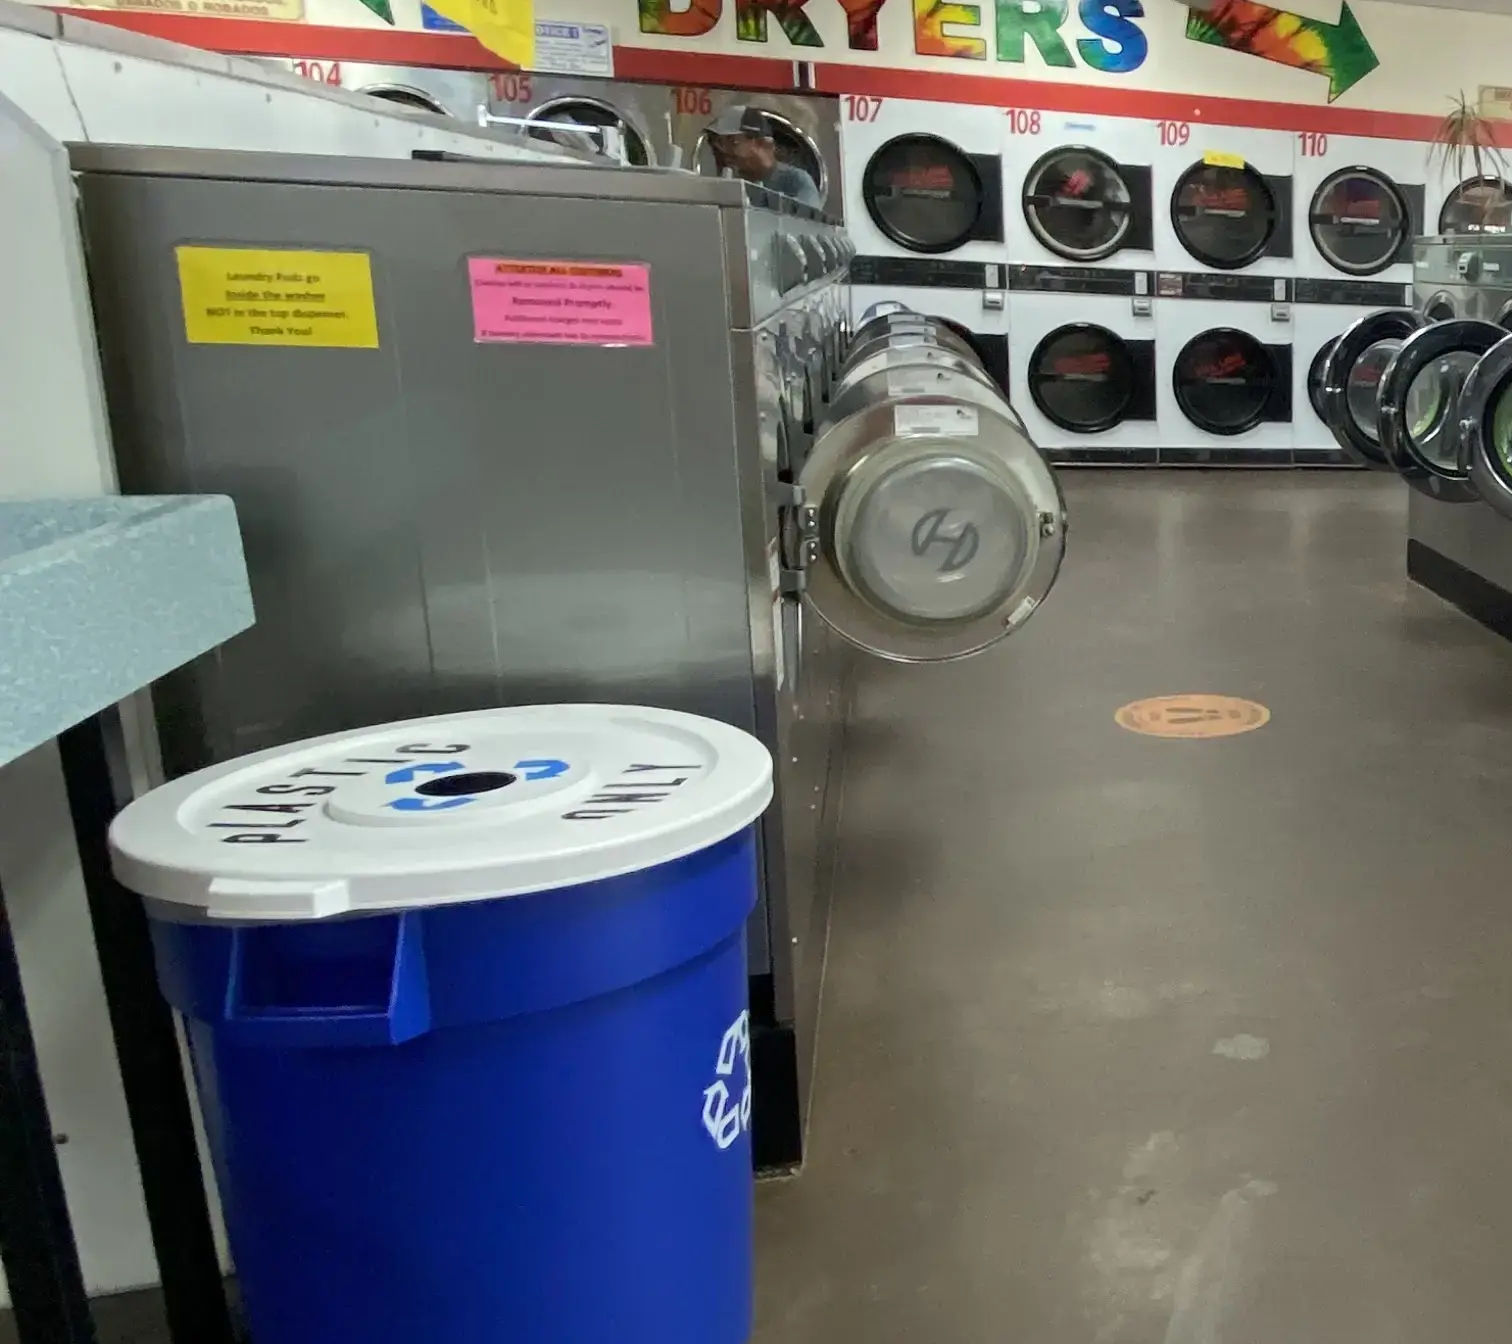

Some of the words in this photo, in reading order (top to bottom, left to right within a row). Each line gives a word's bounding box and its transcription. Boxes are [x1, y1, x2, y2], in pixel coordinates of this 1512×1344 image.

[295, 61, 341, 87] 104
[489, 73, 532, 103] 105
[672, 88, 712, 115] 106
[845, 95, 883, 122] 107
[1004, 109, 1041, 135] 108
[1157, 120, 1190, 146] 109
[1298, 133, 1328, 157] 110
[206, 742, 471, 844] PLASTIC
